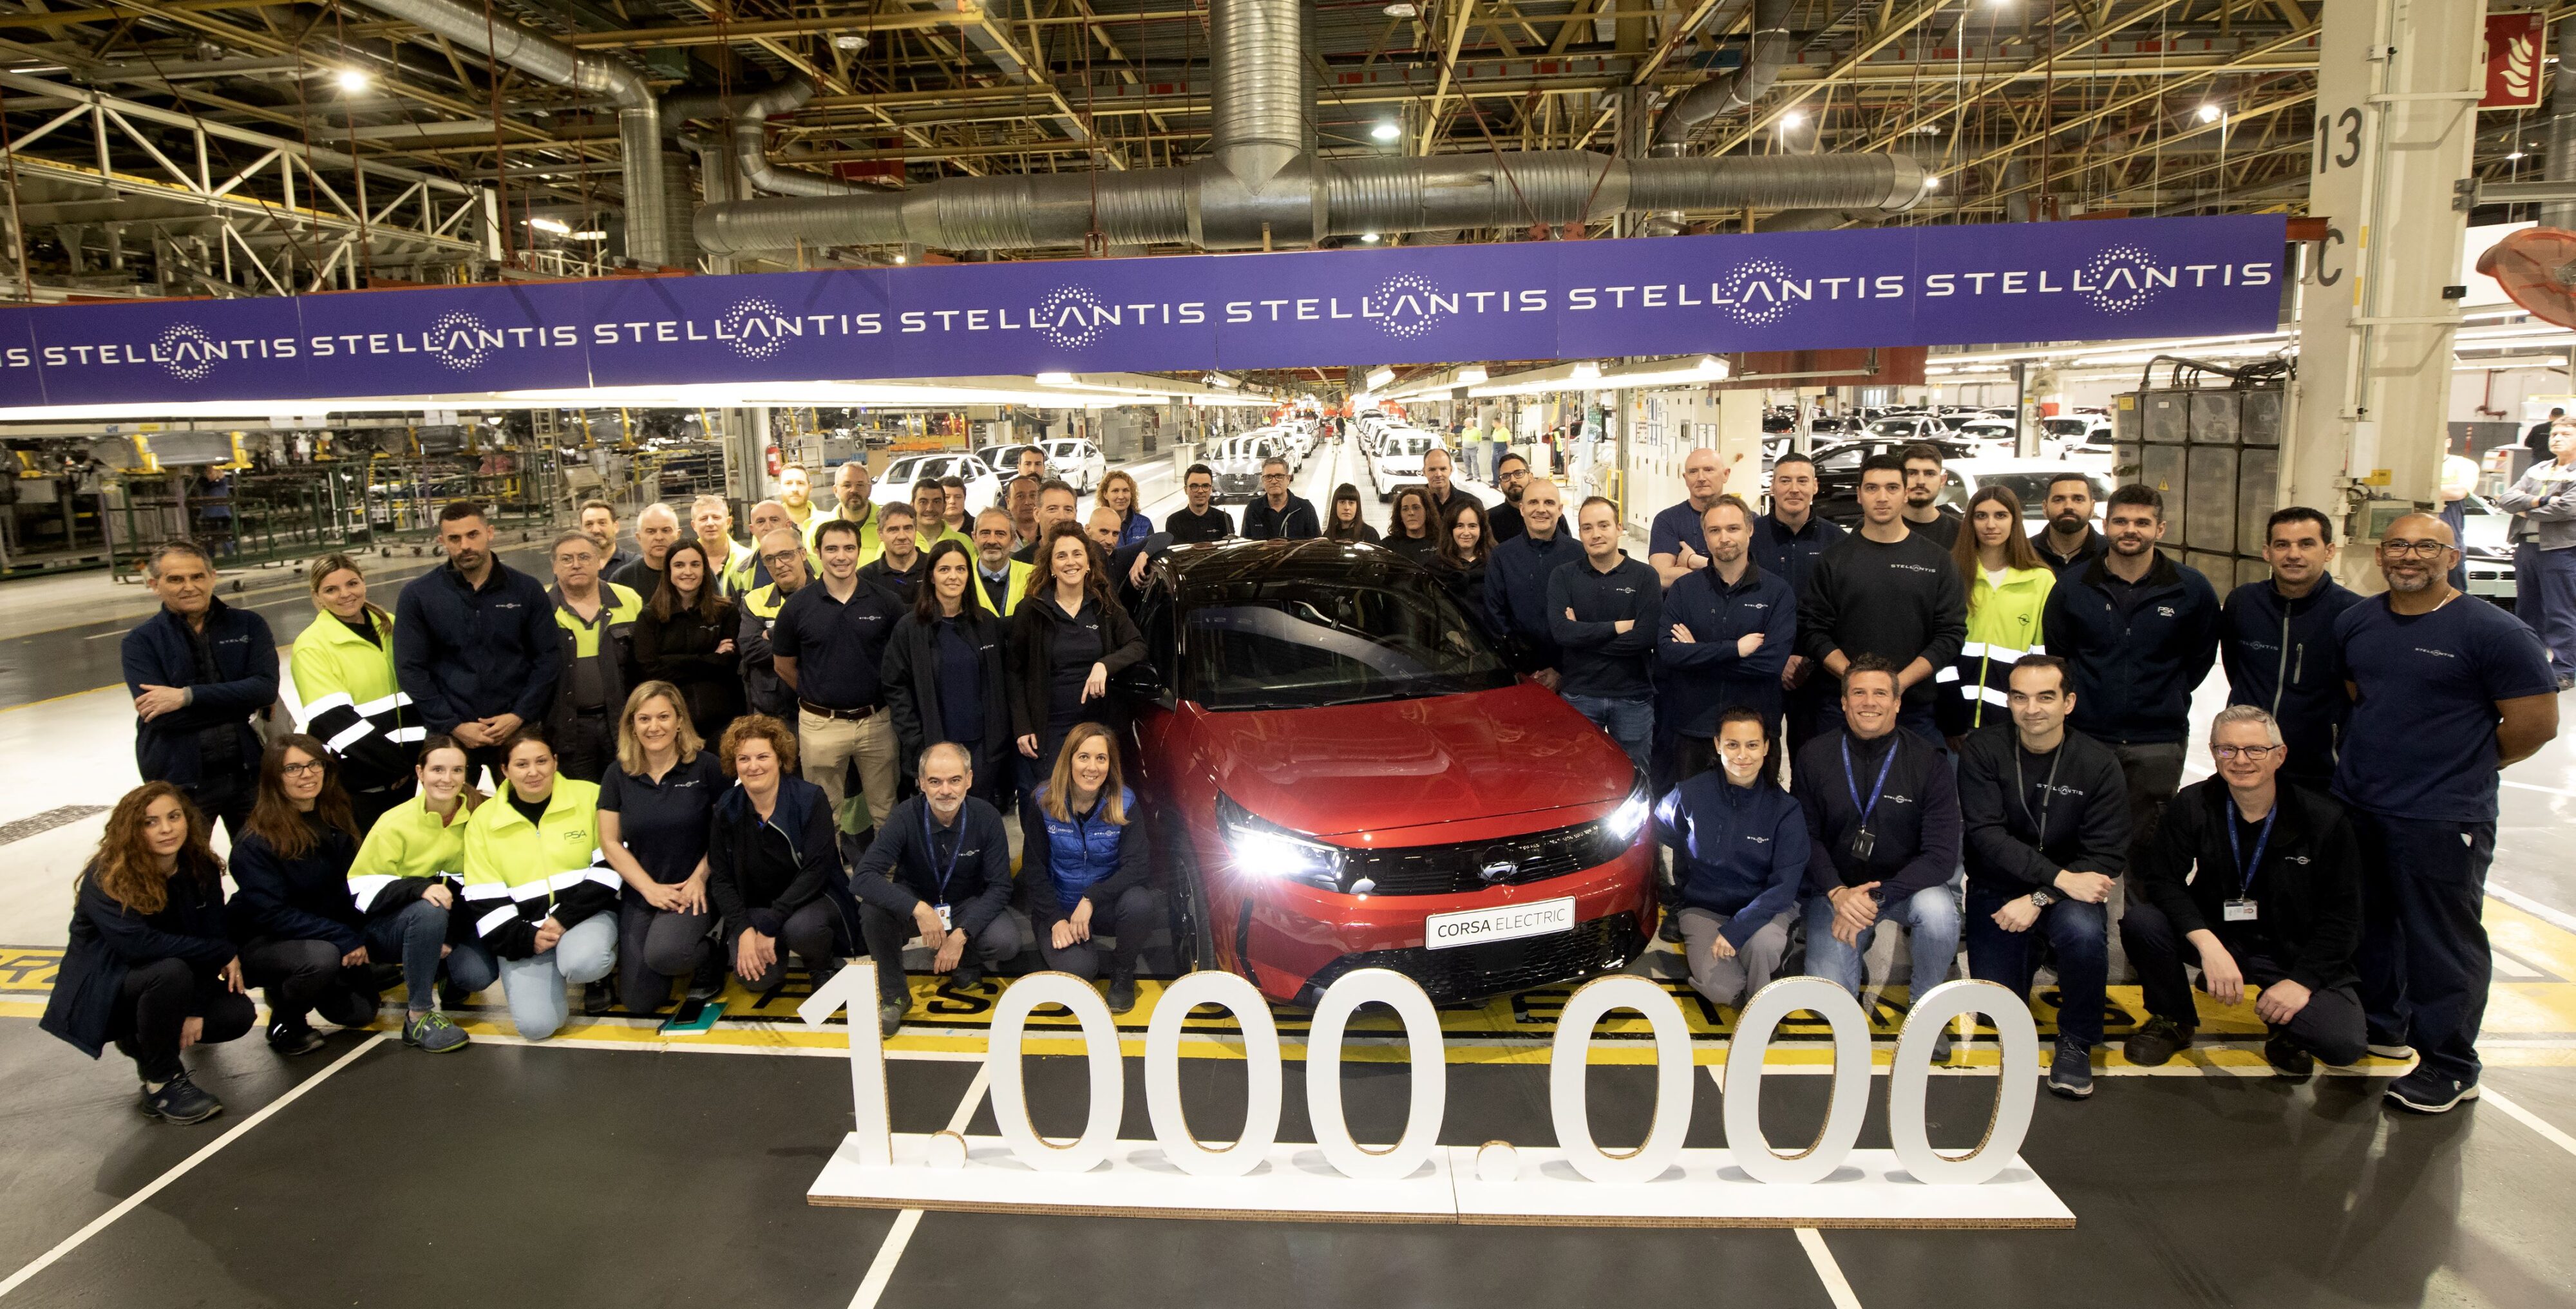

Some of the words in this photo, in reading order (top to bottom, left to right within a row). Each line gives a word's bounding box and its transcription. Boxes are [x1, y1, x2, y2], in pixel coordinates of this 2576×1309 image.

[2318, 107, 2362, 174] 13
[2317, 228, 2344, 287] C
[44, 338, 297, 366] STELLANTIS
[311, 325, 578, 356] STELLANTIS
[594, 313, 882, 344] STELLANTIS
[900, 302, 1206, 333] STELLANTIS
[1226, 289, 1548, 323] STELLANTIS
[1569, 276, 1904, 310] STELLANTIS
[1926, 263, 2272, 297] STELLANTIS
[1891, 564, 1936, 572] STELLANTIS
[2157, 606, 2175, 614] PSA
[2238, 640, 2278, 650] TELLANTIS
[564, 830, 587, 840] PSA
[1437, 919, 1491, 937] CORSA
[1496, 909, 1566, 930] ELECTRIC
